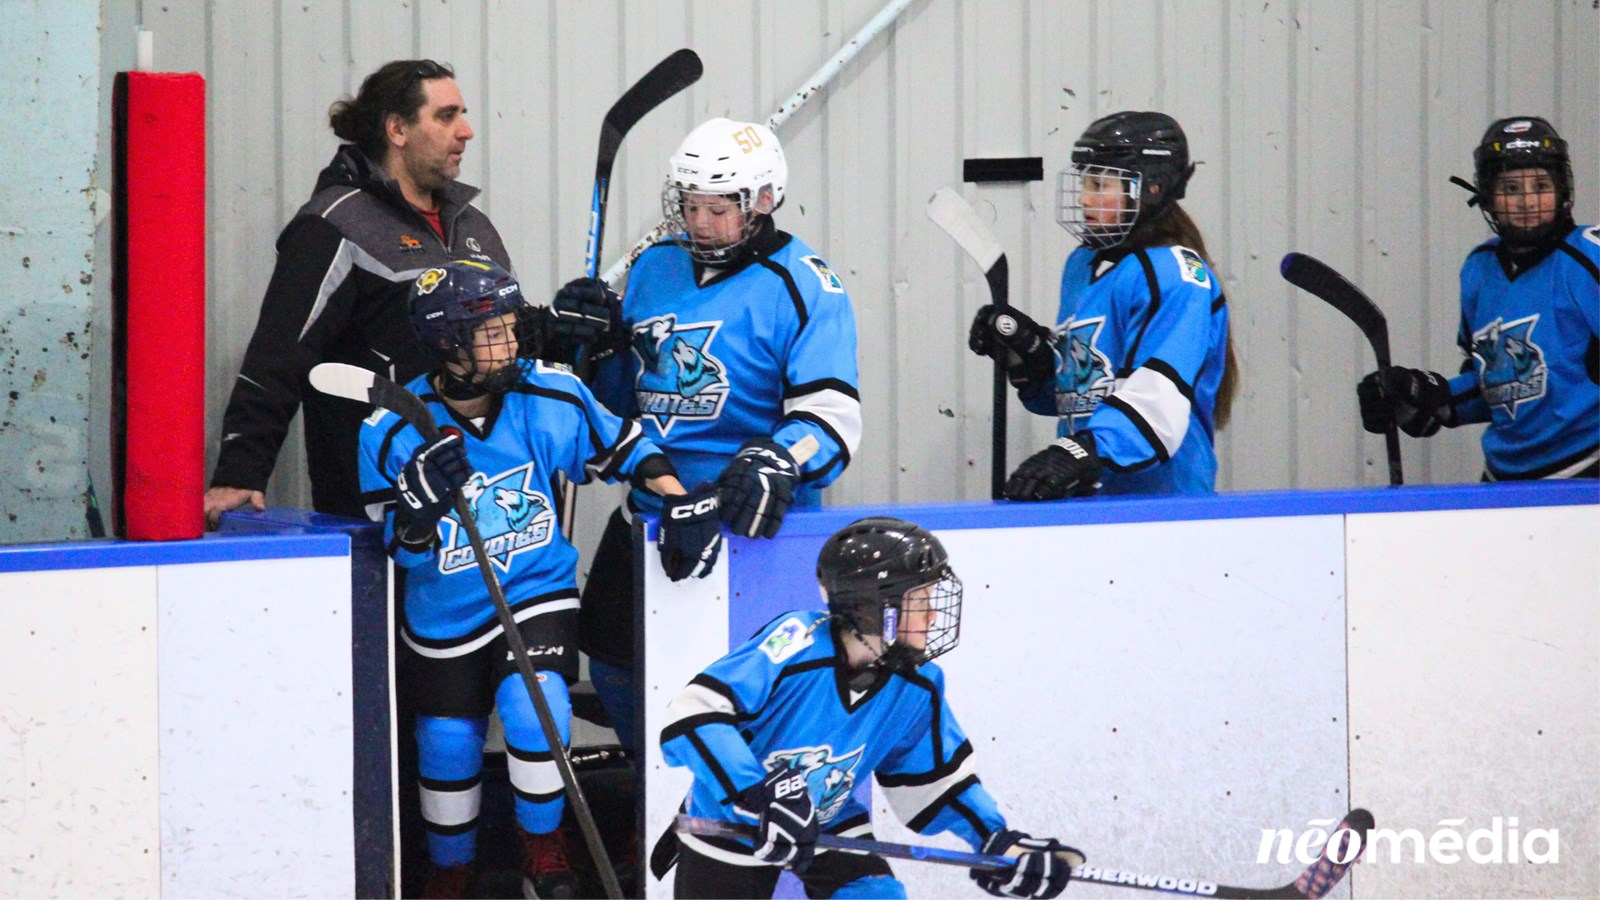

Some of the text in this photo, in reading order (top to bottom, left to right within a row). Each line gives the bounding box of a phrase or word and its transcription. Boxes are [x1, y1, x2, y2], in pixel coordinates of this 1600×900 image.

[732, 125, 762, 153] 50
[498, 283, 519, 296] CCM
[426, 311, 444, 320] CCM
[637, 391, 721, 415] YOTES
[1070, 864, 1218, 896] SHERWOOD
